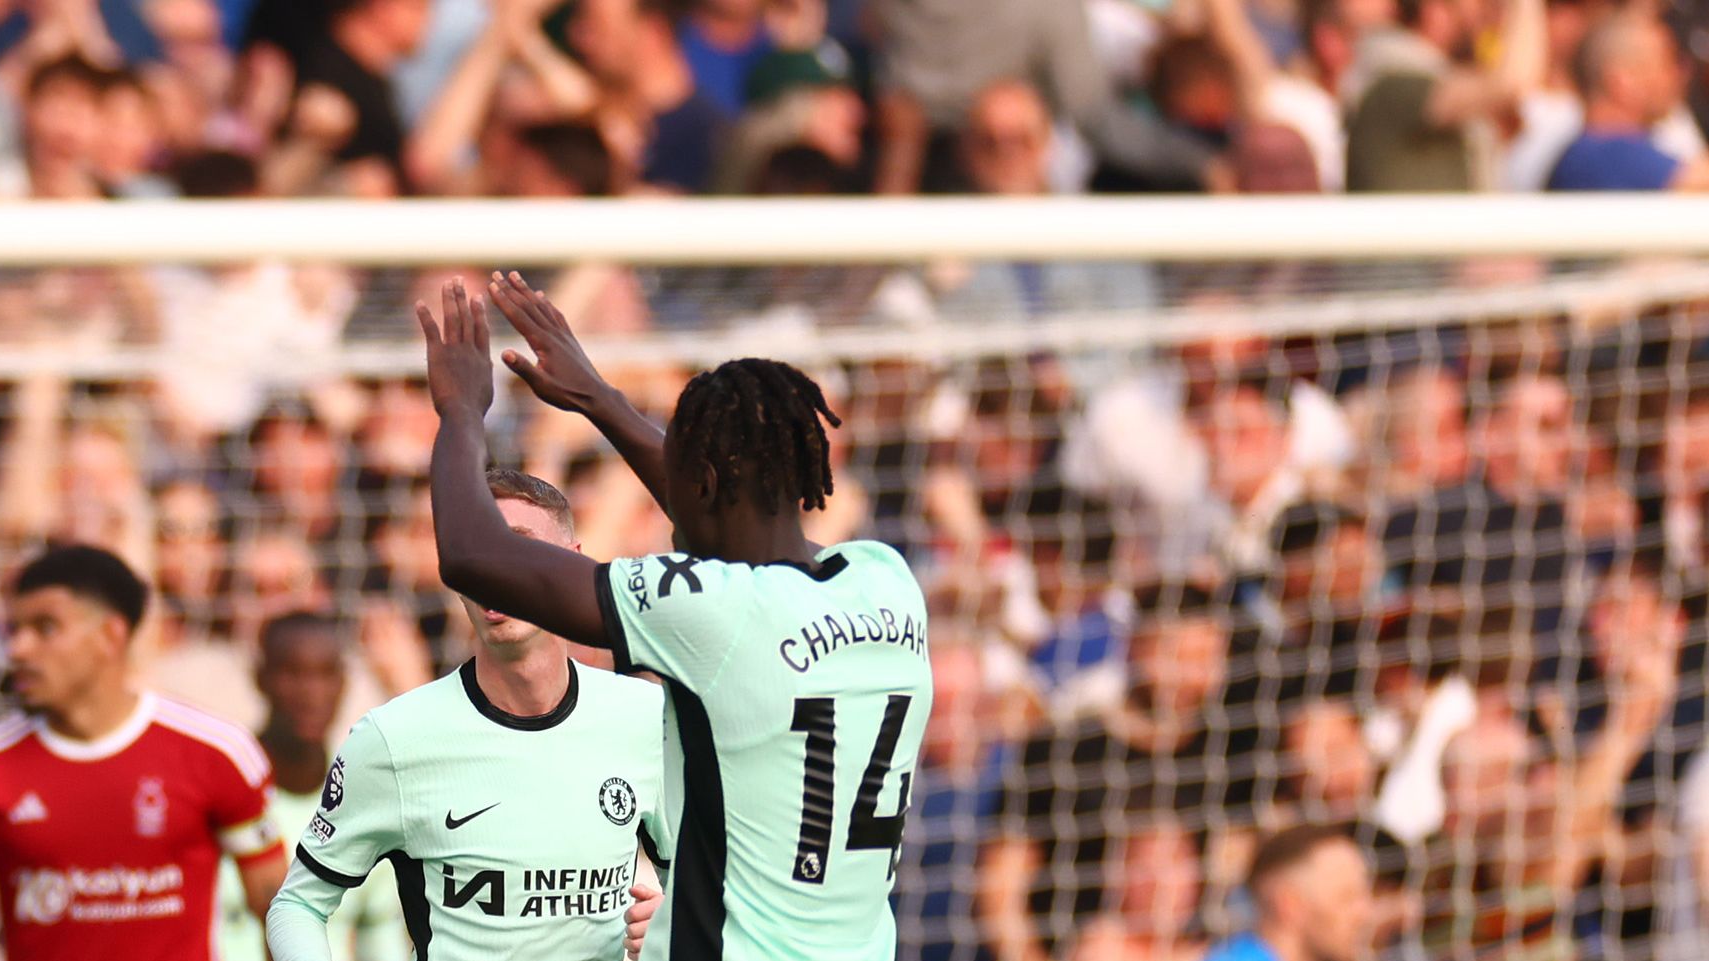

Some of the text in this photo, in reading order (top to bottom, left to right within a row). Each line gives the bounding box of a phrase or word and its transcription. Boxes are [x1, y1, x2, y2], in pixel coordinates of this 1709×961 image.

[780, 608, 926, 673] CHALOBAH
[790, 694, 913, 885] 14
[523, 860, 630, 891] INFINITE
[520, 885, 628, 918] ATHLETE
